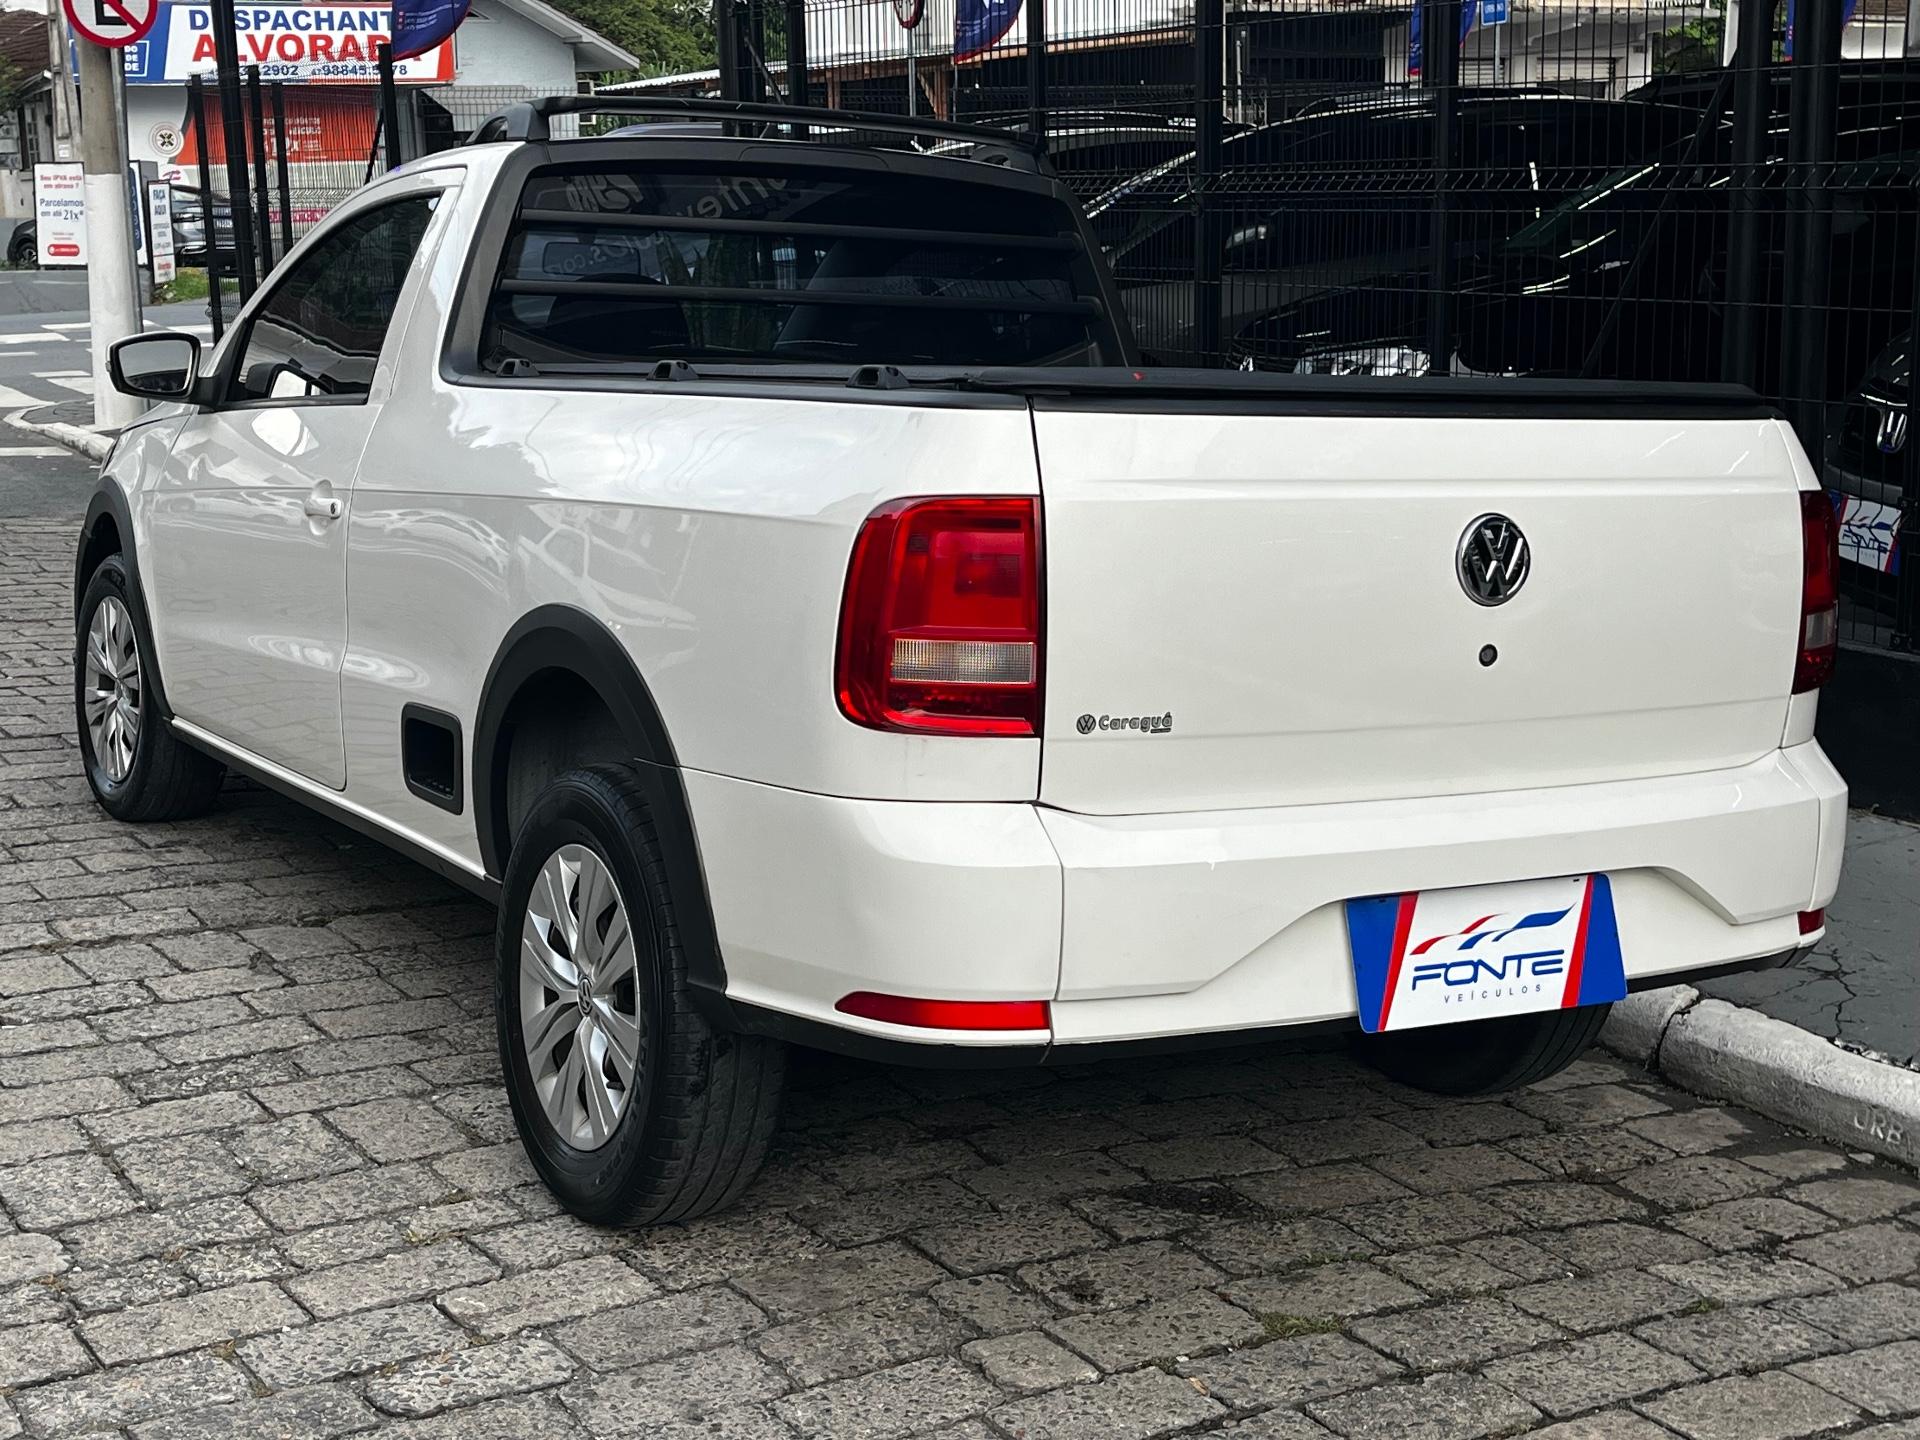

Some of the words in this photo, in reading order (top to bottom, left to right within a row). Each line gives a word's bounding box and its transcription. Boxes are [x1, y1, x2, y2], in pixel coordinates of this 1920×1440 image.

[39, 198, 84, 208] Parcelamos
[52, 208, 63, 217] até
[1098, 711, 1172, 733] Caraguá
[1411, 949, 1565, 991] FONTE
[1443, 983, 1542, 1004] VEÍCULOS
